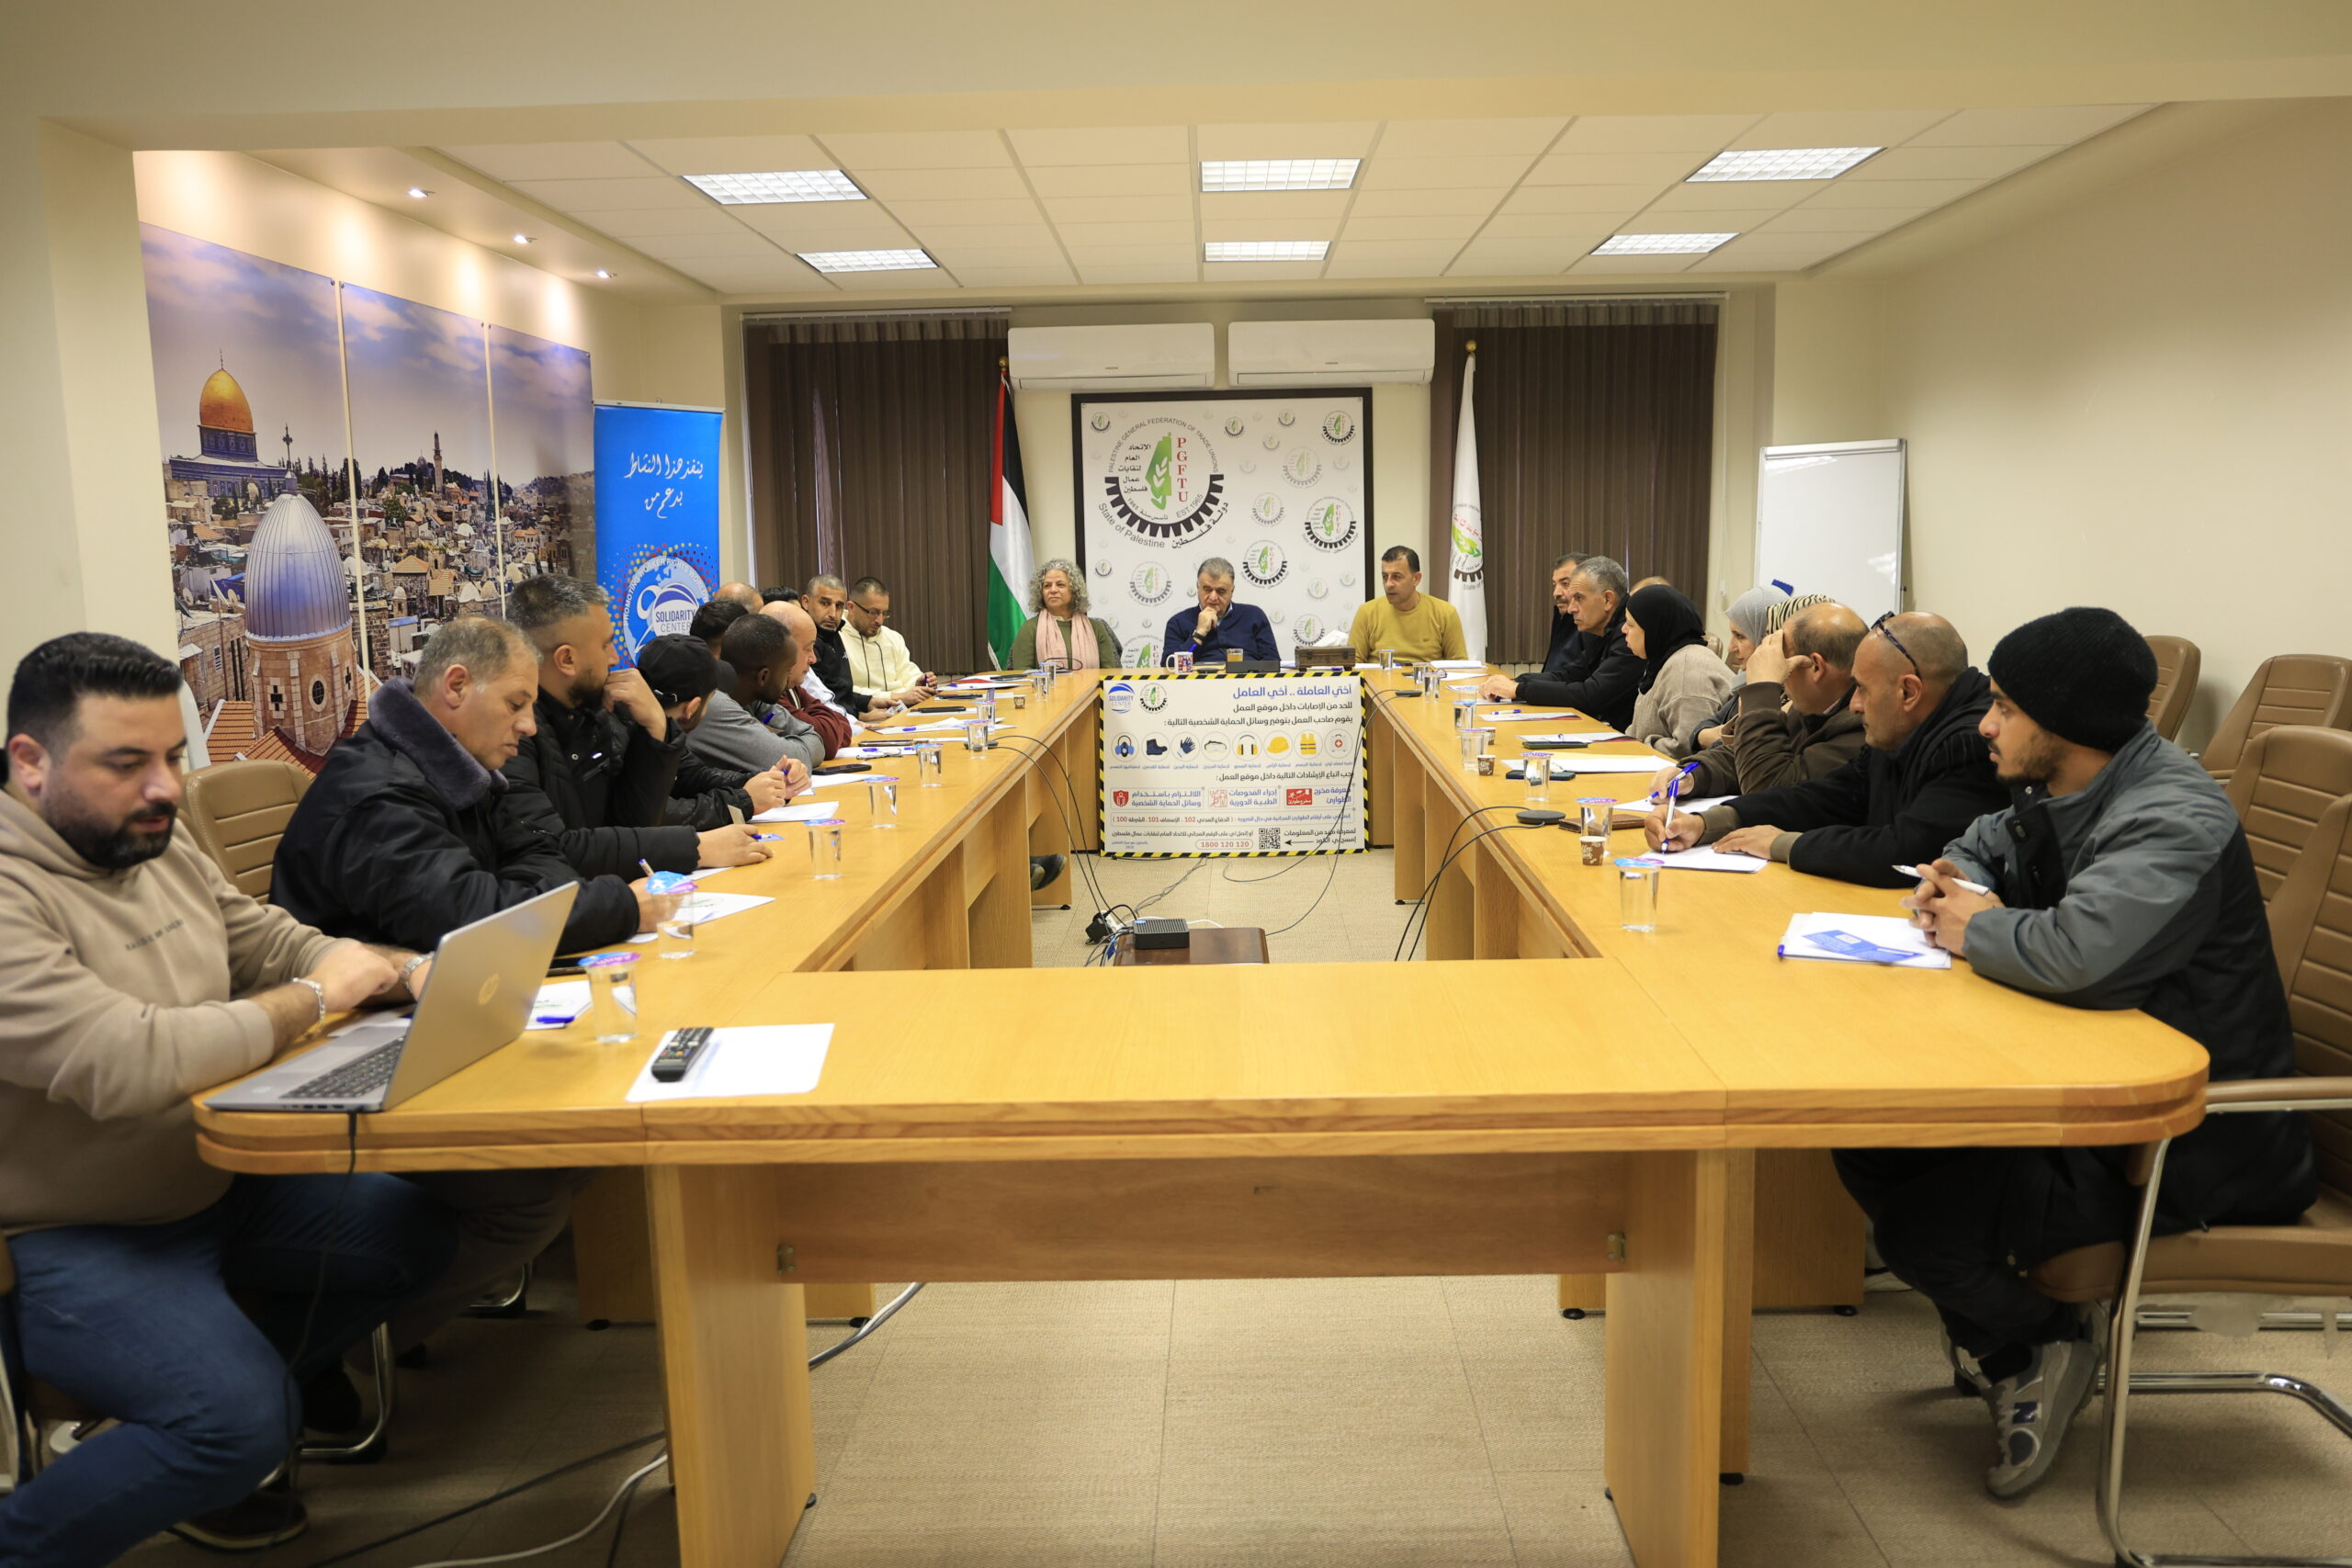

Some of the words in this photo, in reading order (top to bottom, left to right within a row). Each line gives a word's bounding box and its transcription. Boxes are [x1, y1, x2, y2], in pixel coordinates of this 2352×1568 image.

[1109, 440, 1123, 472] PALESTINE
[1122, 422, 1147, 441] GENERAL
[1148, 418, 1186, 427] FEDERATION
[1187, 423, 1195, 432] OF
[1196, 431, 1211, 448] TRADE
[624, 451, 662, 479] النشاط
[664, 453, 684, 479] هذا
[679, 458, 704, 479] ينفذ
[644, 491, 661, 511] من
[1099, 502, 1115, 525] State
[1114, 525, 1125, 534] of
[1125, 530, 1165, 548] Palestine
[624, 573, 640, 626] PROMOTING
[656, 609, 695, 623] SOLIDARITY
[1233, 687, 1265, 699] العامل
[1268, 685, 1287, 698] أخي
[1296, 685, 1330, 695] العاملة
[1331, 683, 1352, 698] أختي
[1233, 704, 1256, 713] العمل
[1279, 703, 1296, 712] داخل
[1296, 702, 1326, 710] الإصابات
[1167, 718, 1188, 727] التالية
[1189, 718, 1219, 727] الشخصية
[1220, 718, 1245, 727] الحماية
[1246, 717, 1268, 726] وسائل
[1270, 717, 1290, 726] بتوفير
[1291, 716, 1312, 725] العمل
[1219, 773, 1239, 782] العمل
[1261, 773, 1276, 782] داخل
